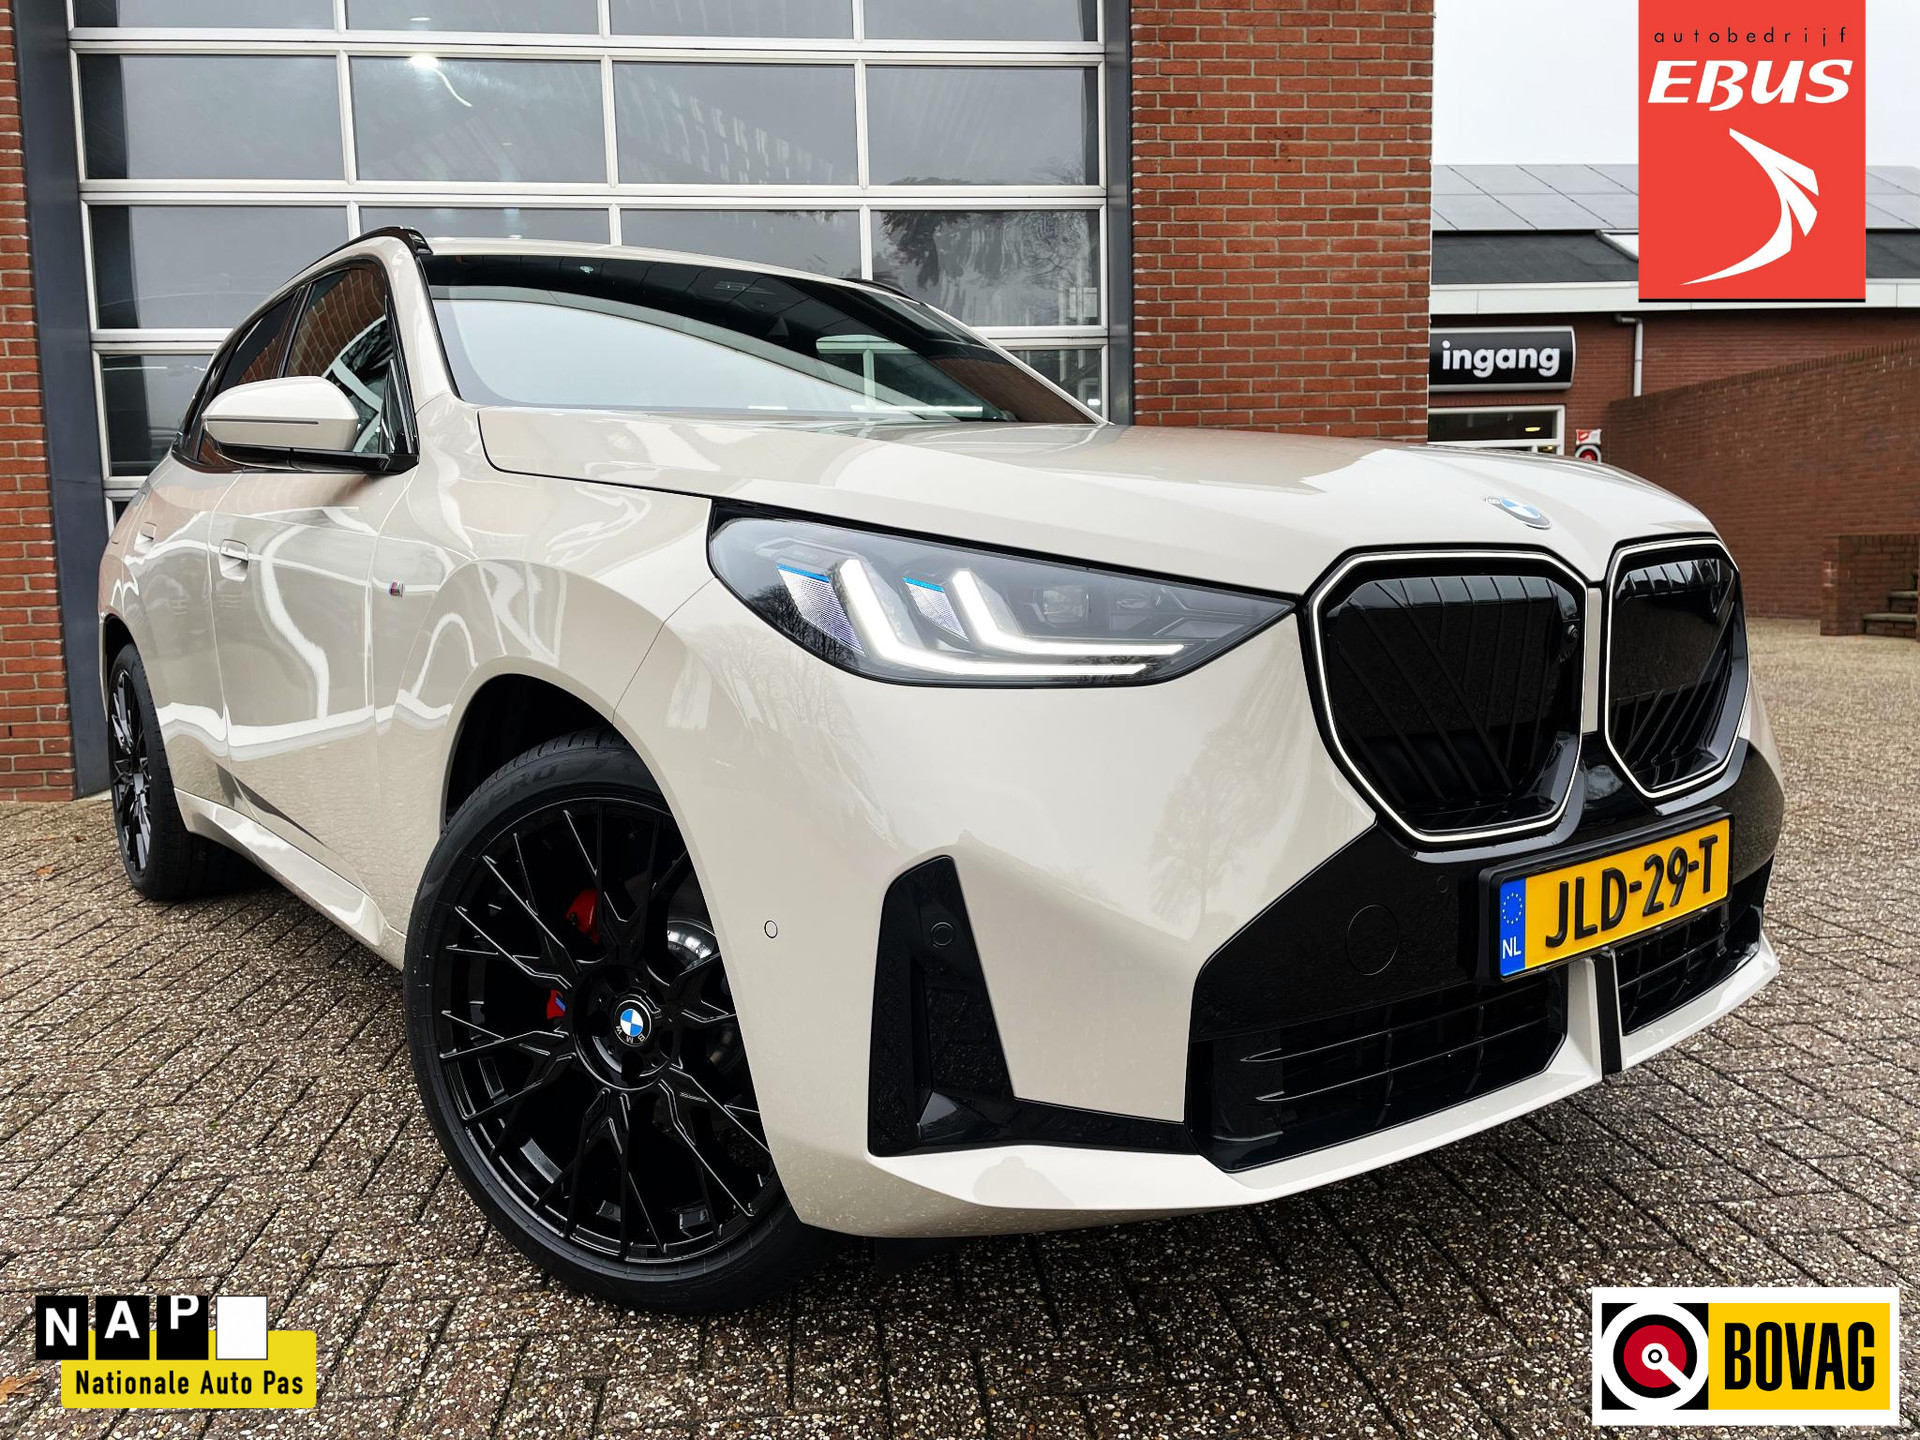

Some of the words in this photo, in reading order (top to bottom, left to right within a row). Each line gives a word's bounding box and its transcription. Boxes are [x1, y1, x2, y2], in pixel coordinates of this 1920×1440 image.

[1441, 339, 1561, 379] ingang
[1545, 834, 1719, 949] JLD-29-T
[1501, 936, 1522, 960] NL
[615, 1024, 646, 1045] BMW
